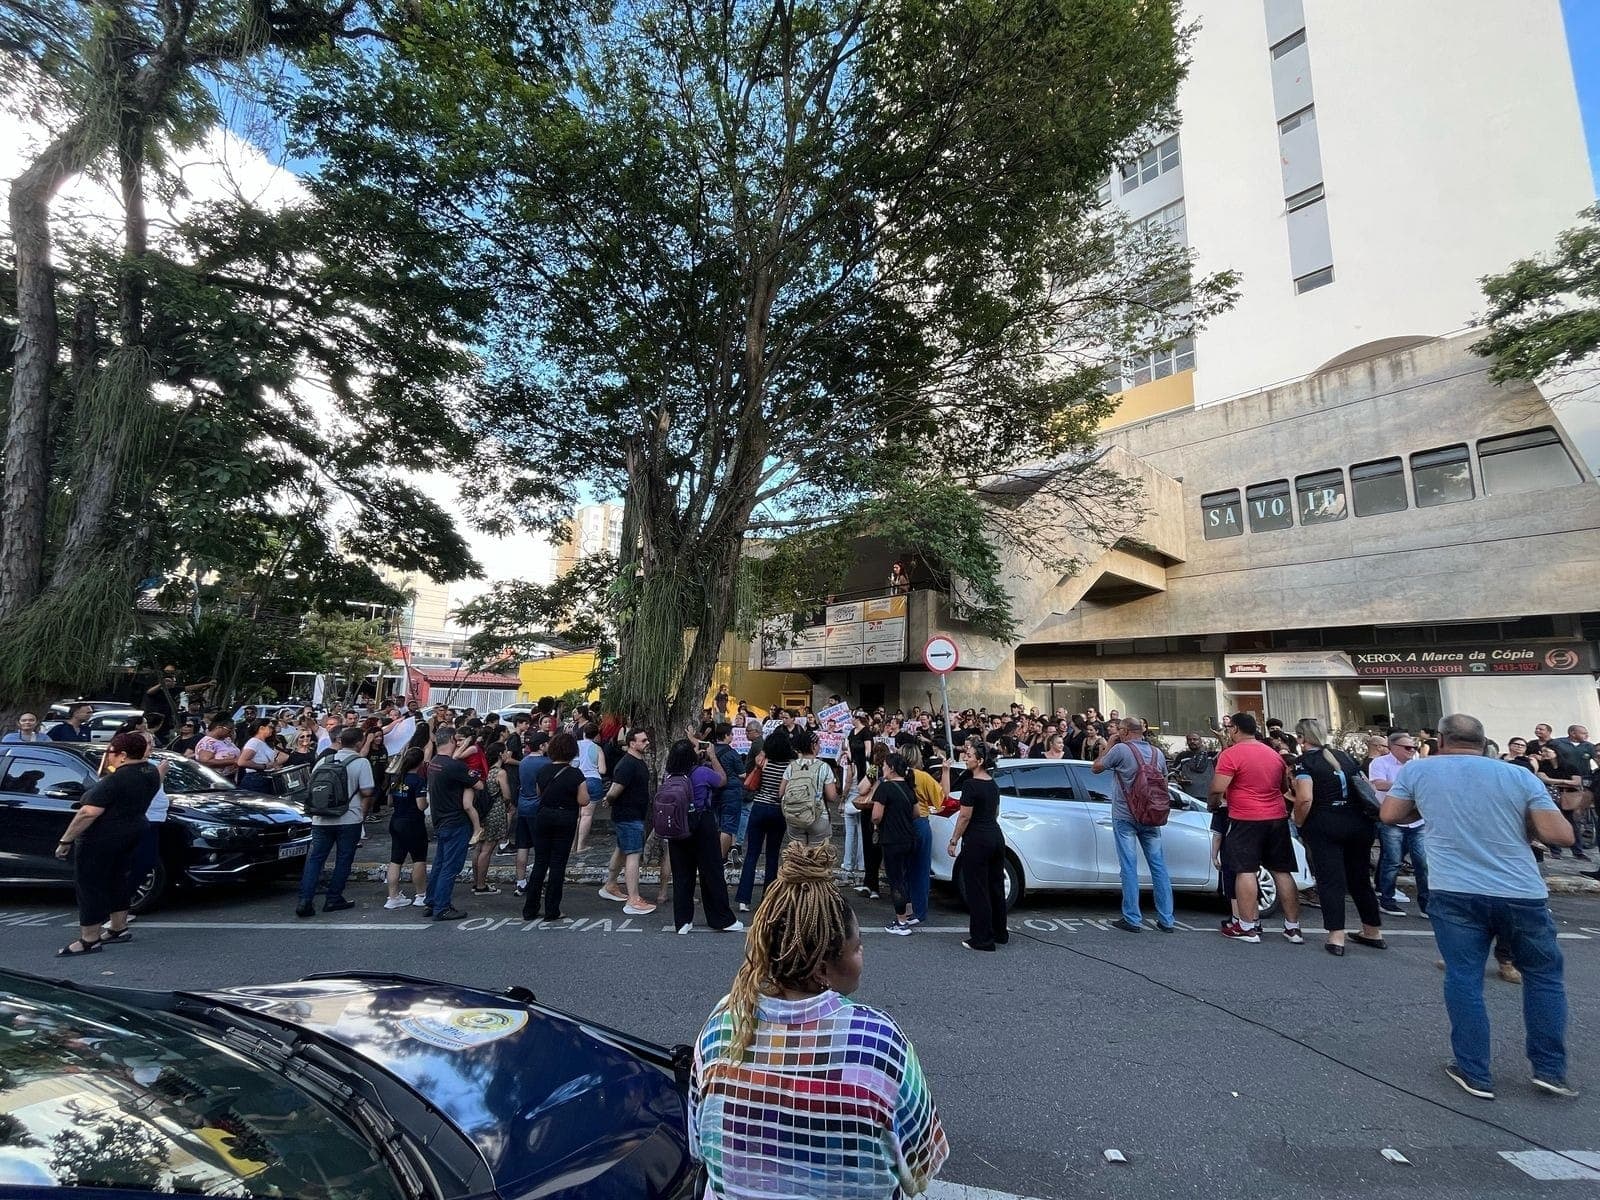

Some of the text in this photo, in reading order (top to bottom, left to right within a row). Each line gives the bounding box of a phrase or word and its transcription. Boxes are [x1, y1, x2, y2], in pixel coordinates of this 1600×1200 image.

[1357, 649, 1535, 663] XEROX A Marca da Cópia
[1364, 666, 1427, 674] COPIADORA
[1429, 665, 1463, 673] GROH
